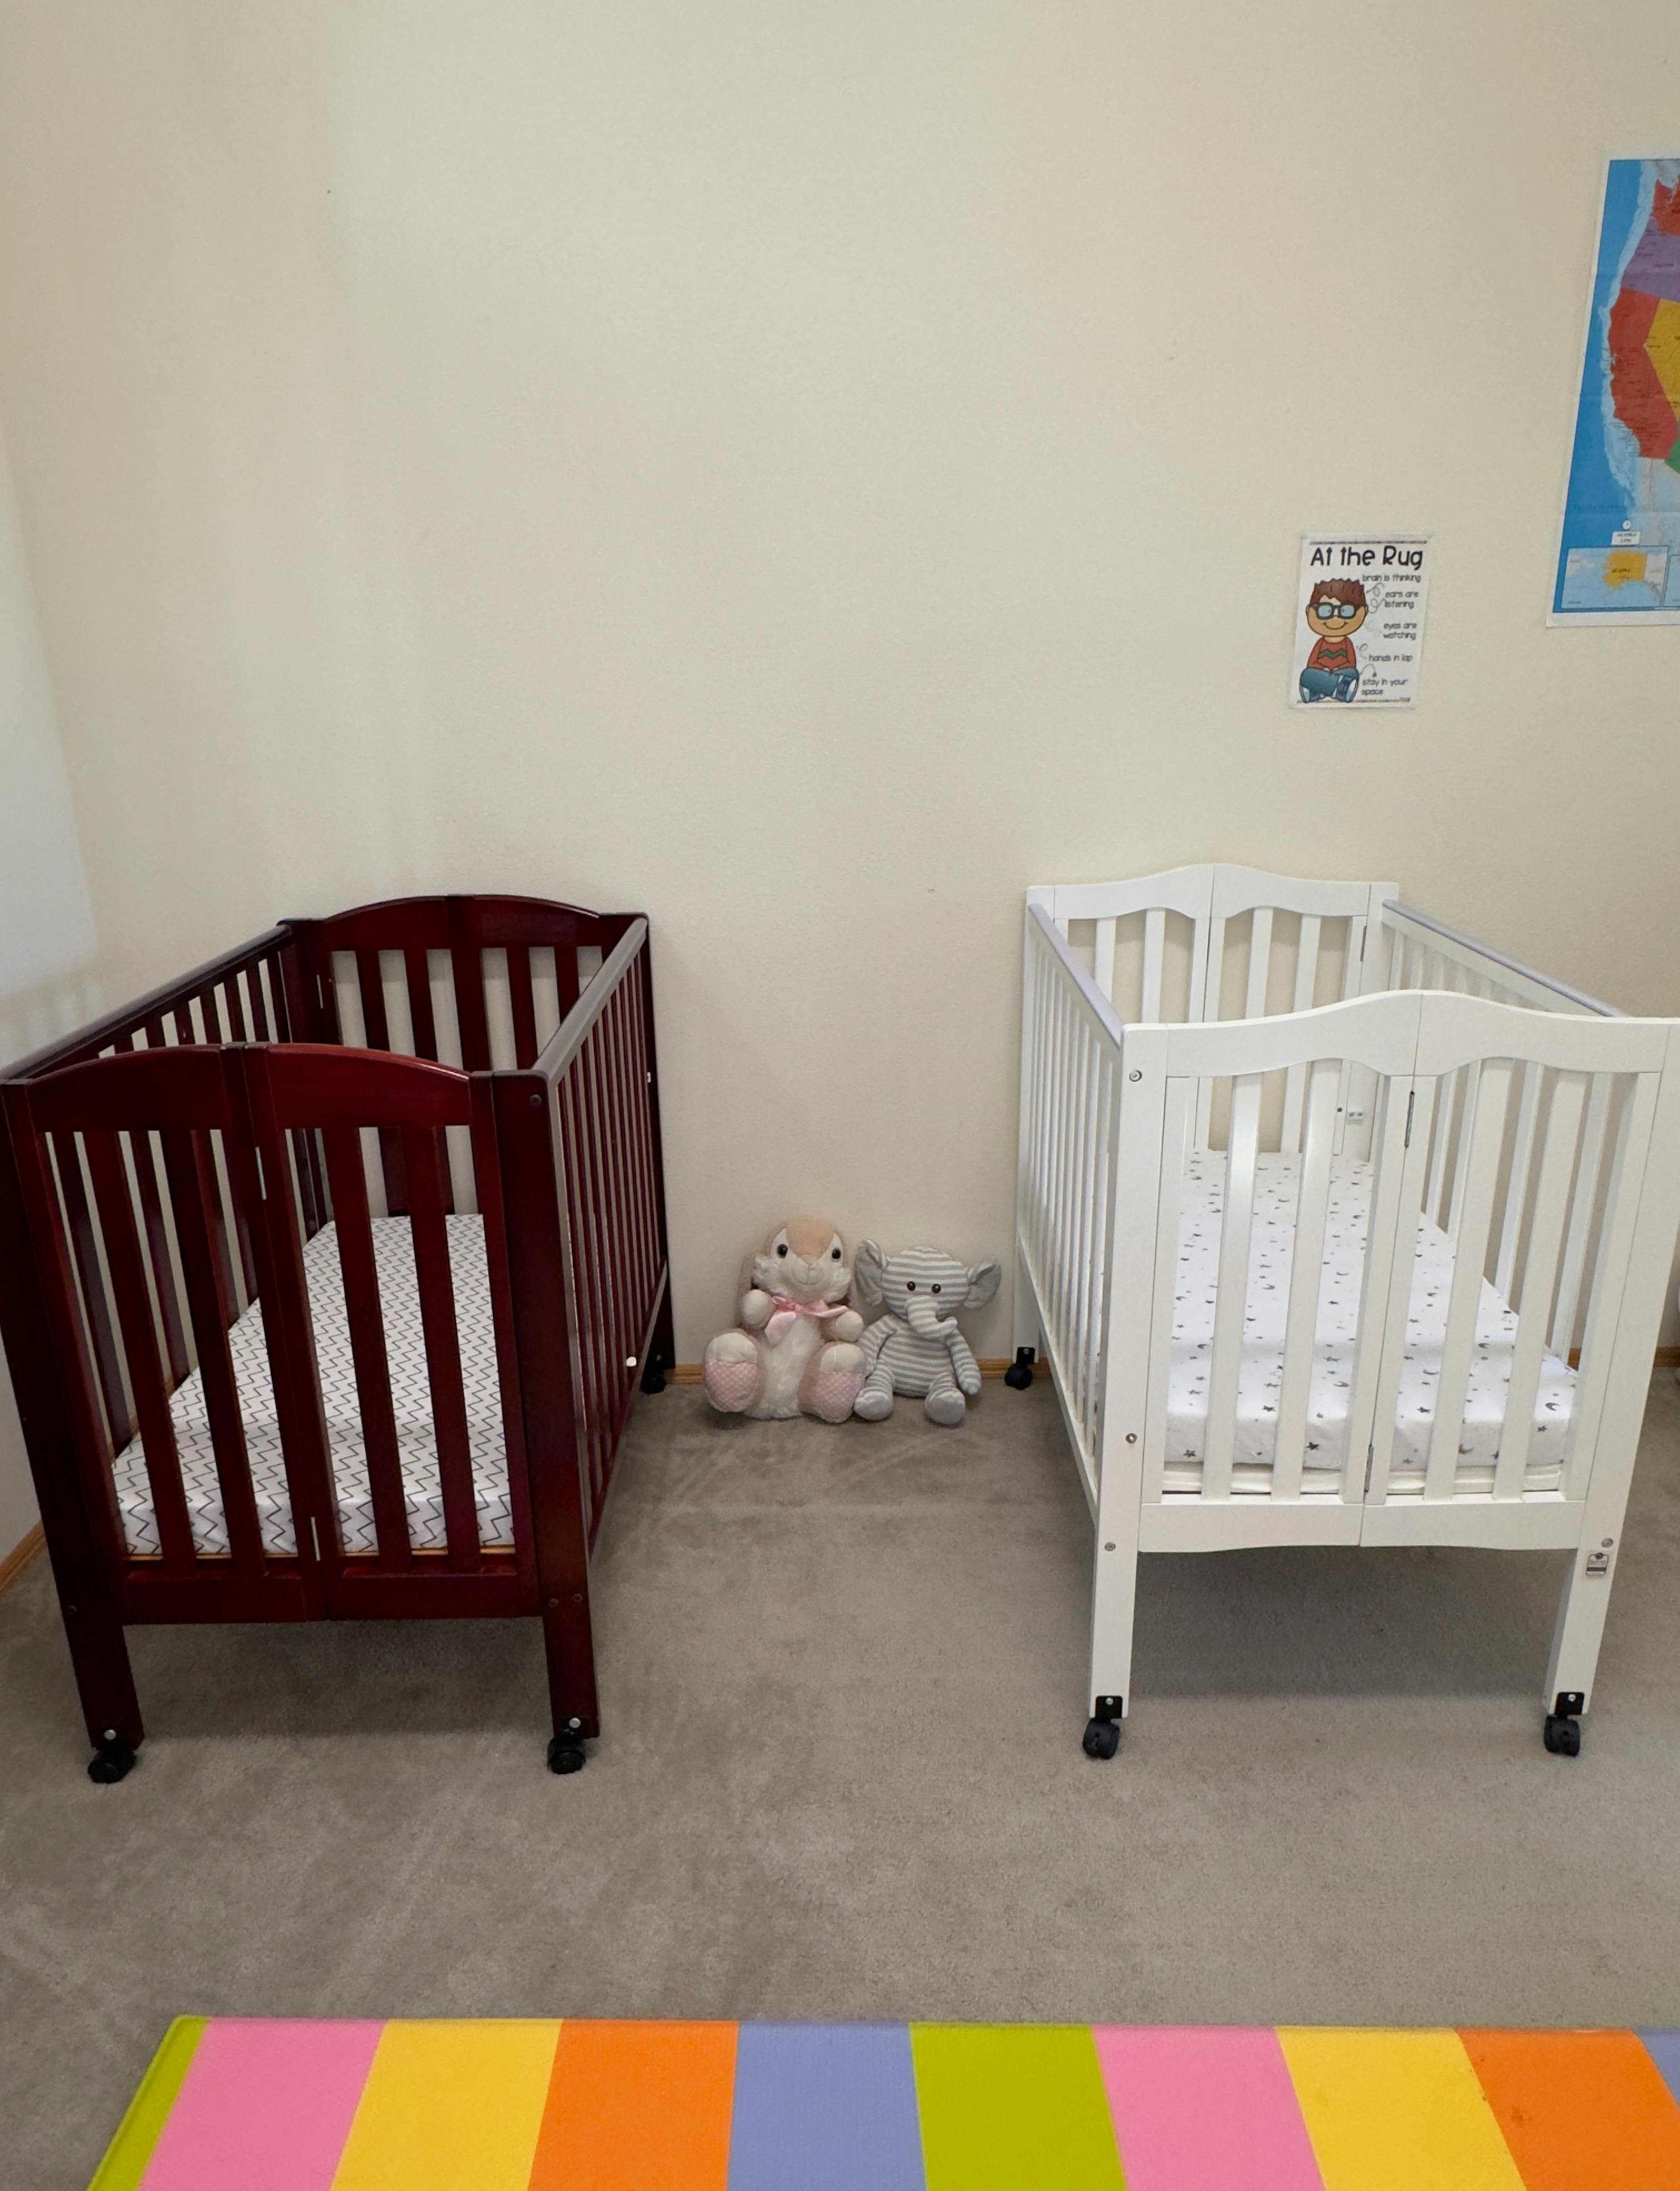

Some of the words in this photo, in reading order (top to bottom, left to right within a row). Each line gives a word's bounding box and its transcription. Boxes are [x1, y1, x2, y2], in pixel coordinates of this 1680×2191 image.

[1311, 547, 1332, 566] At
[1341, 546, 1375, 566] the
[1383, 545, 1423, 571] Rug
[1392, 573, 1421, 583] thinking
[1384, 600, 1414, 609] listening
[1383, 632, 1416, 640] watching
[1402, 653, 1413, 662] lap
[1362, 678, 1379, 687] stay
